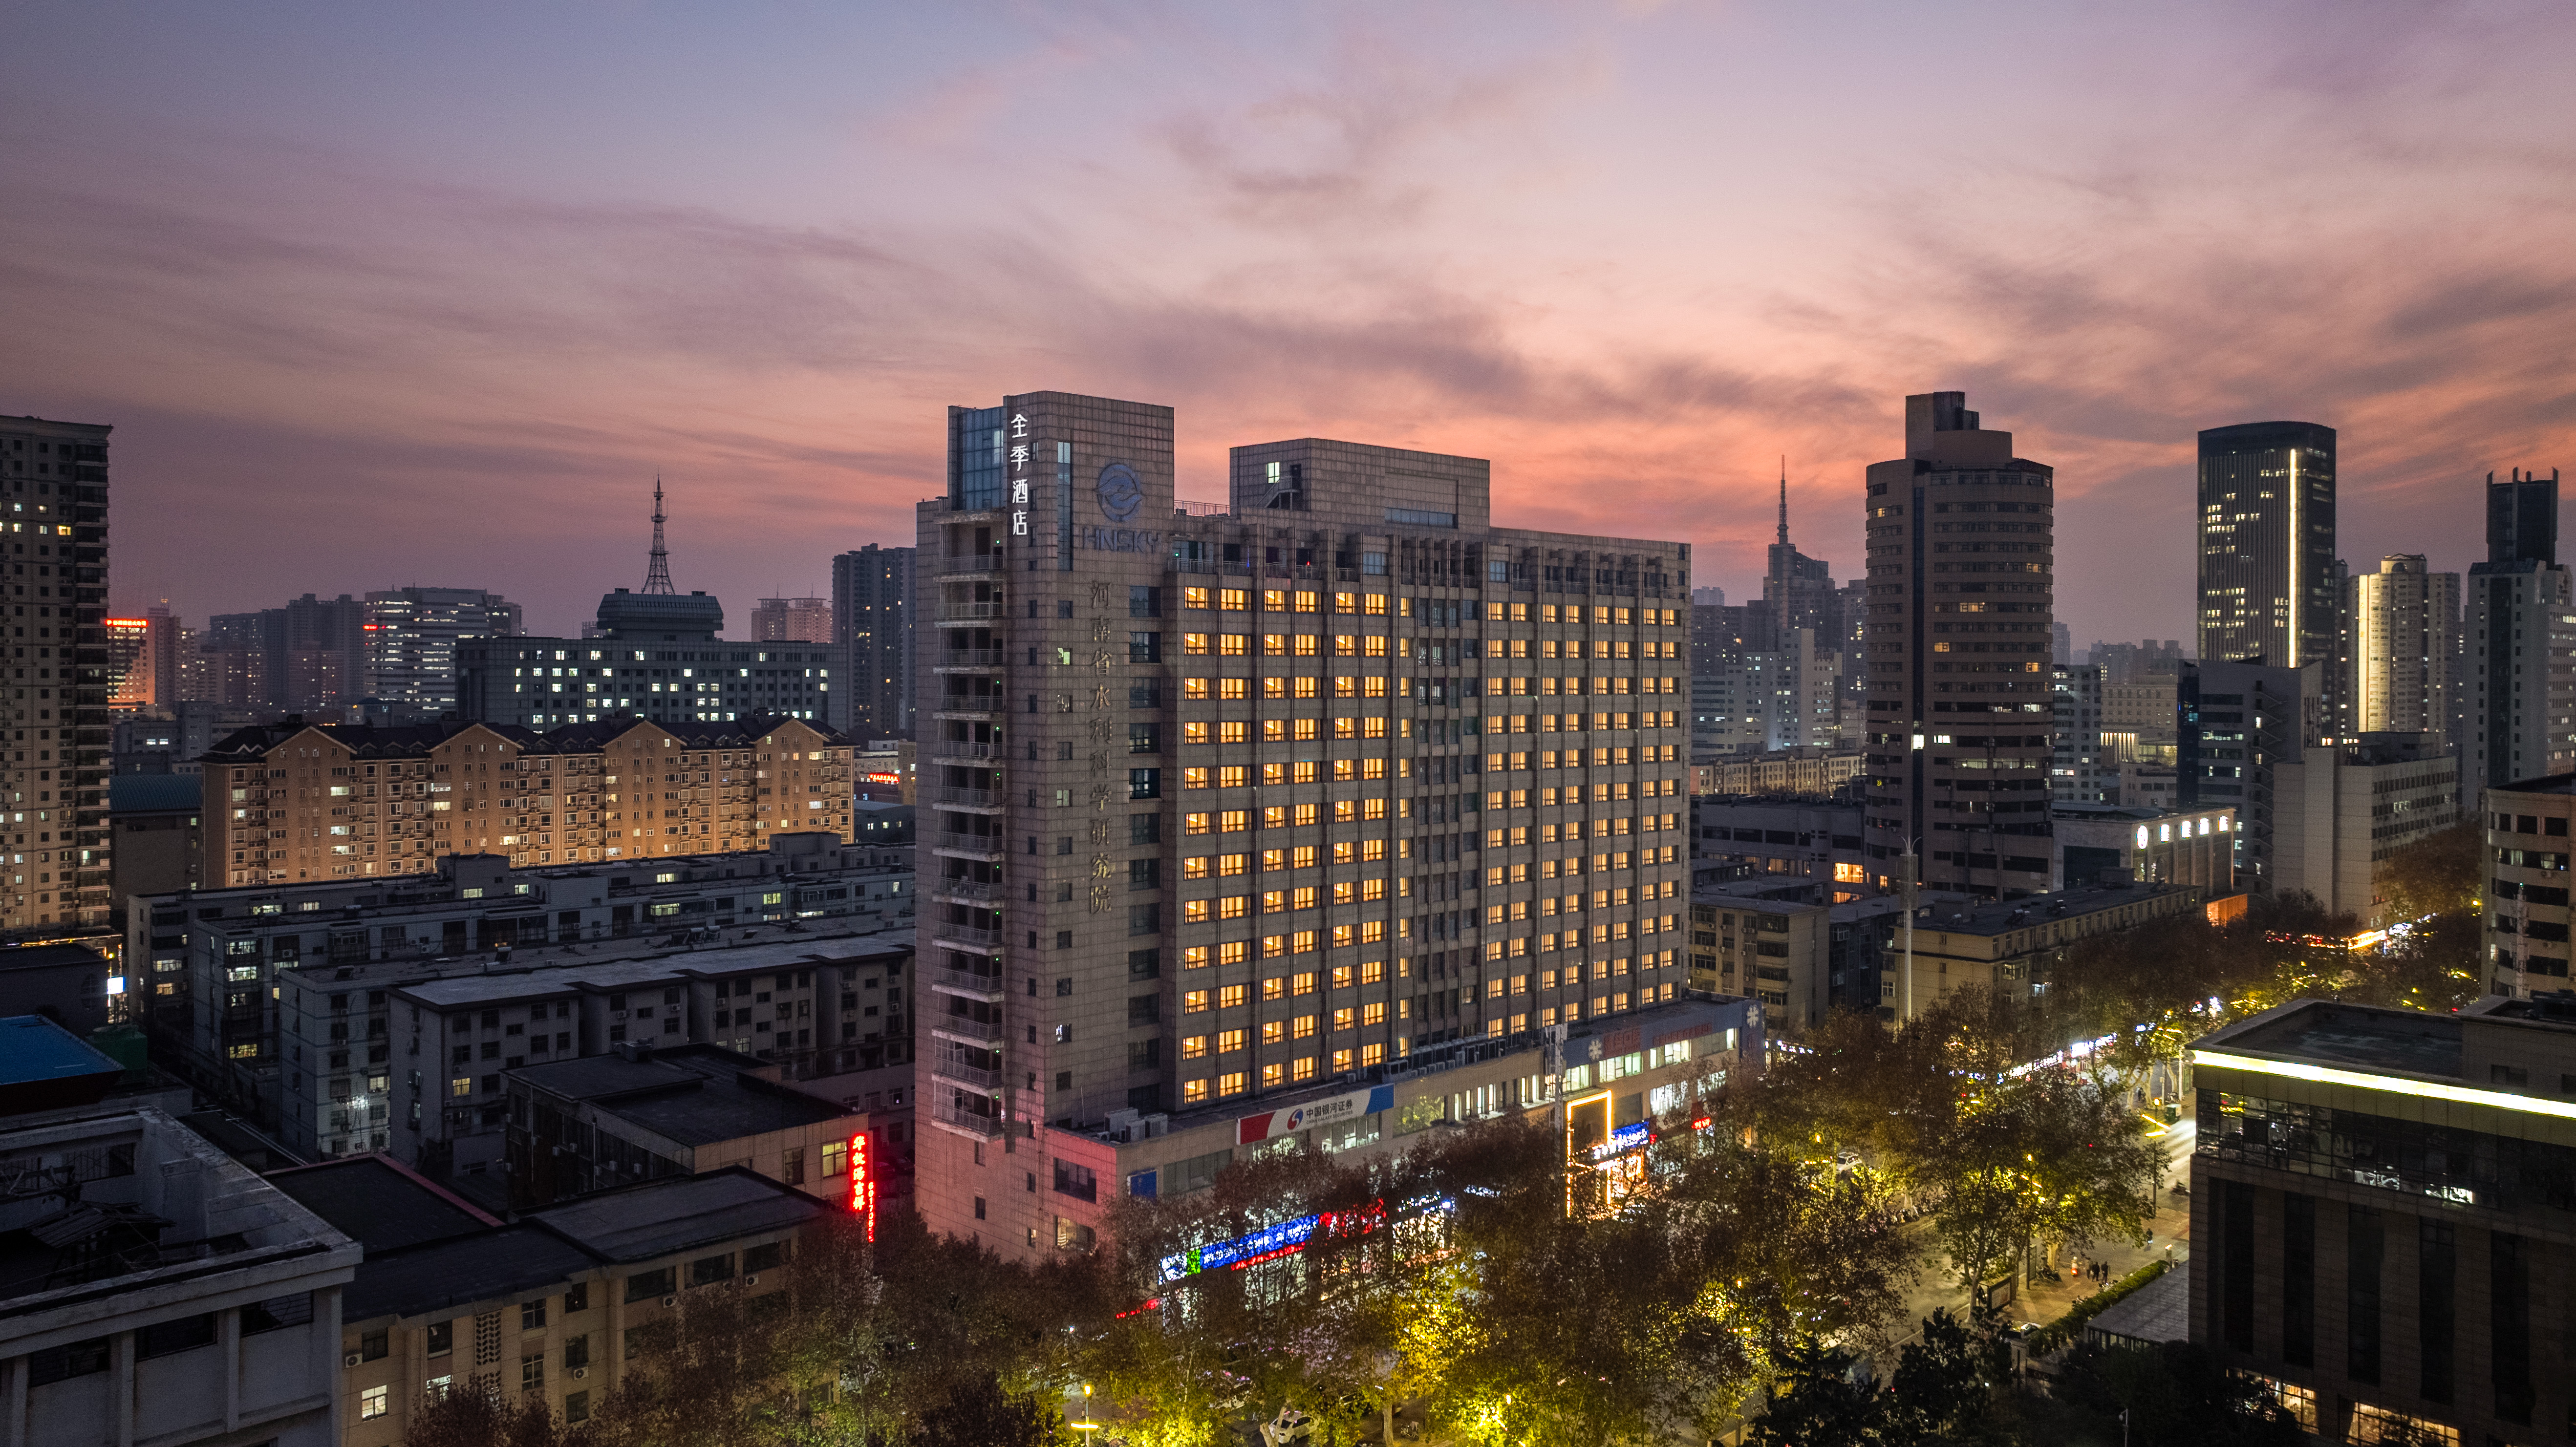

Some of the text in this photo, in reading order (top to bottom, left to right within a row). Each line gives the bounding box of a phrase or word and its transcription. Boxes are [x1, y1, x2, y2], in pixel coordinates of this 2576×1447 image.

[1010, 413, 1029, 535] 全季酒店
[1083, 528, 1161, 553] HNSKY
[1089, 580, 1112, 915] 河南省水利科学研究院
[1306, 1099, 1353, 1119] 中国银河证券
[1332, 1110, 1353, 1119] SECURITIES
